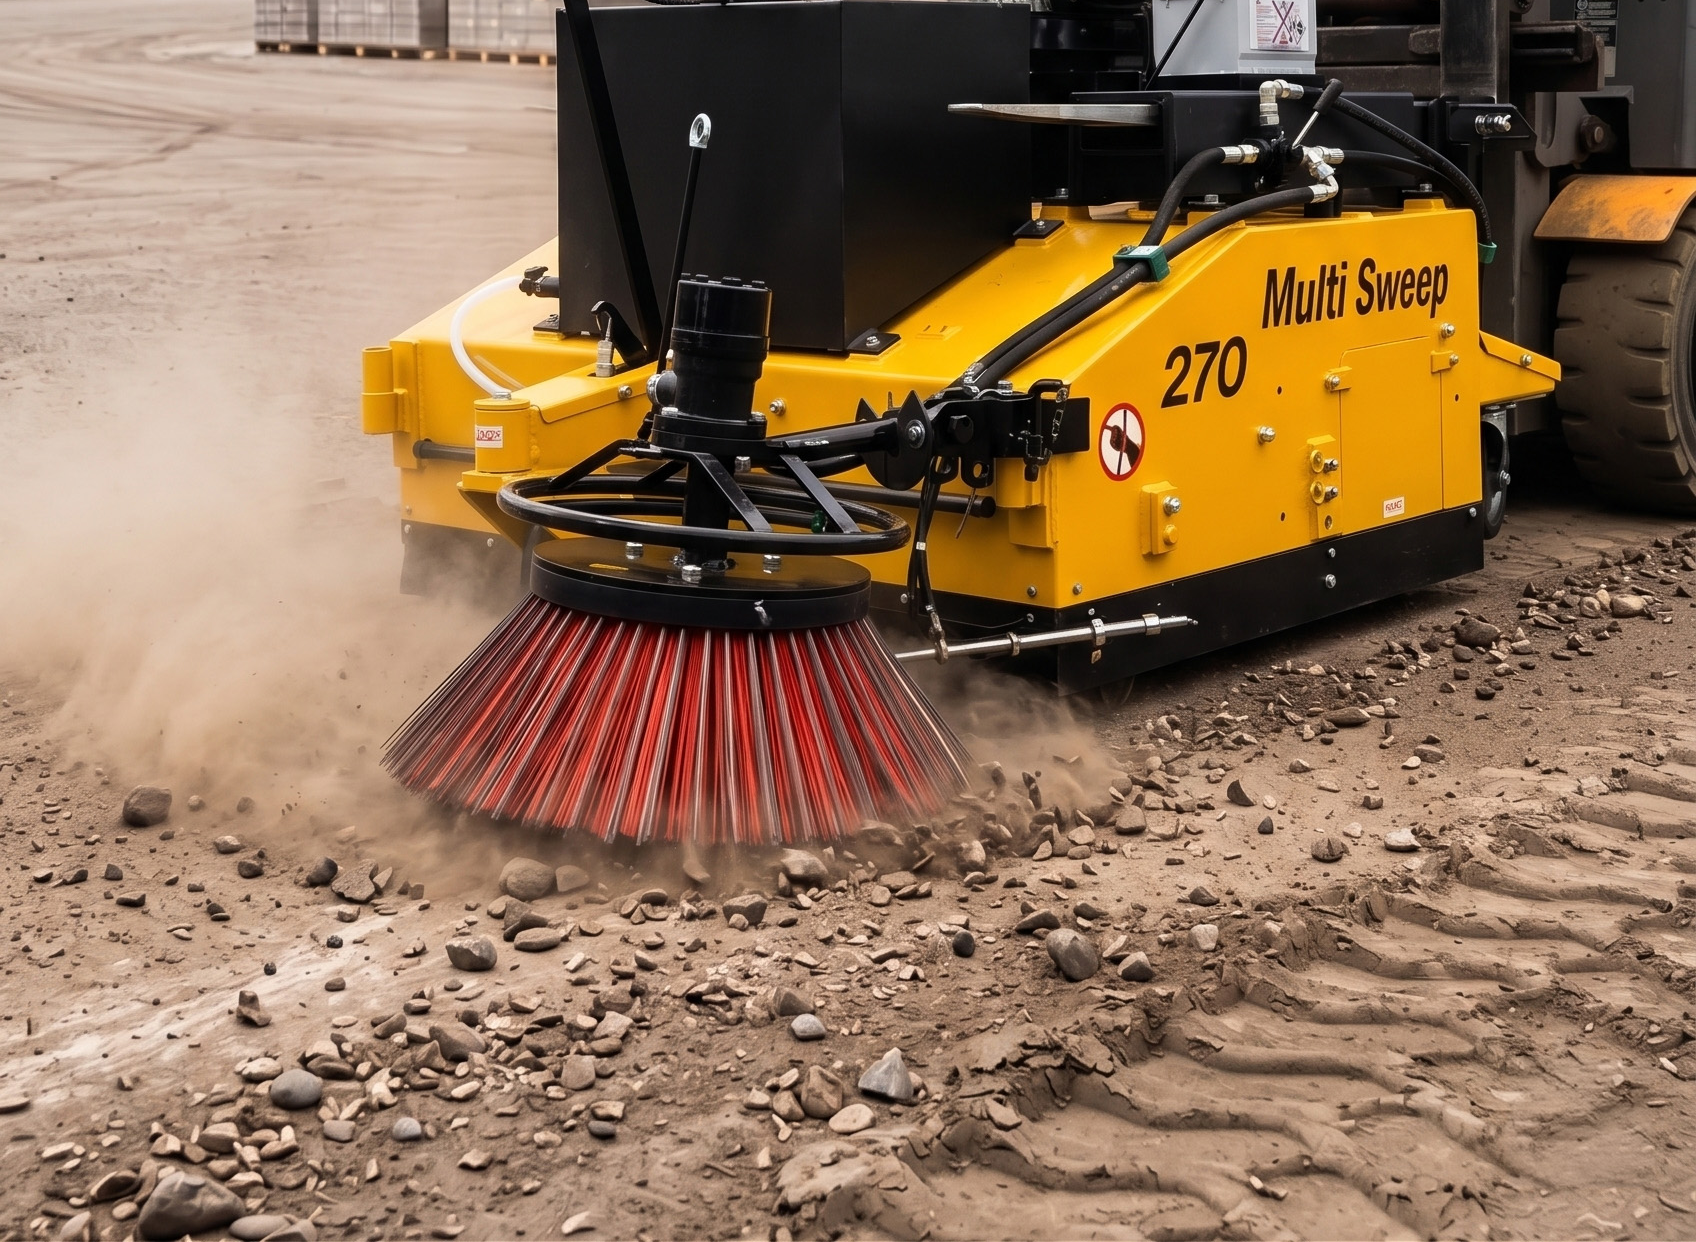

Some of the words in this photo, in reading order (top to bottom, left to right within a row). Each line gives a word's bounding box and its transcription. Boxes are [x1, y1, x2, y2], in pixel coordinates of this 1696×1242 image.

[1262, 261, 1348, 329] Multi
[1355, 257, 1449, 319] Sweep
[1161, 336, 1248, 408] 270
